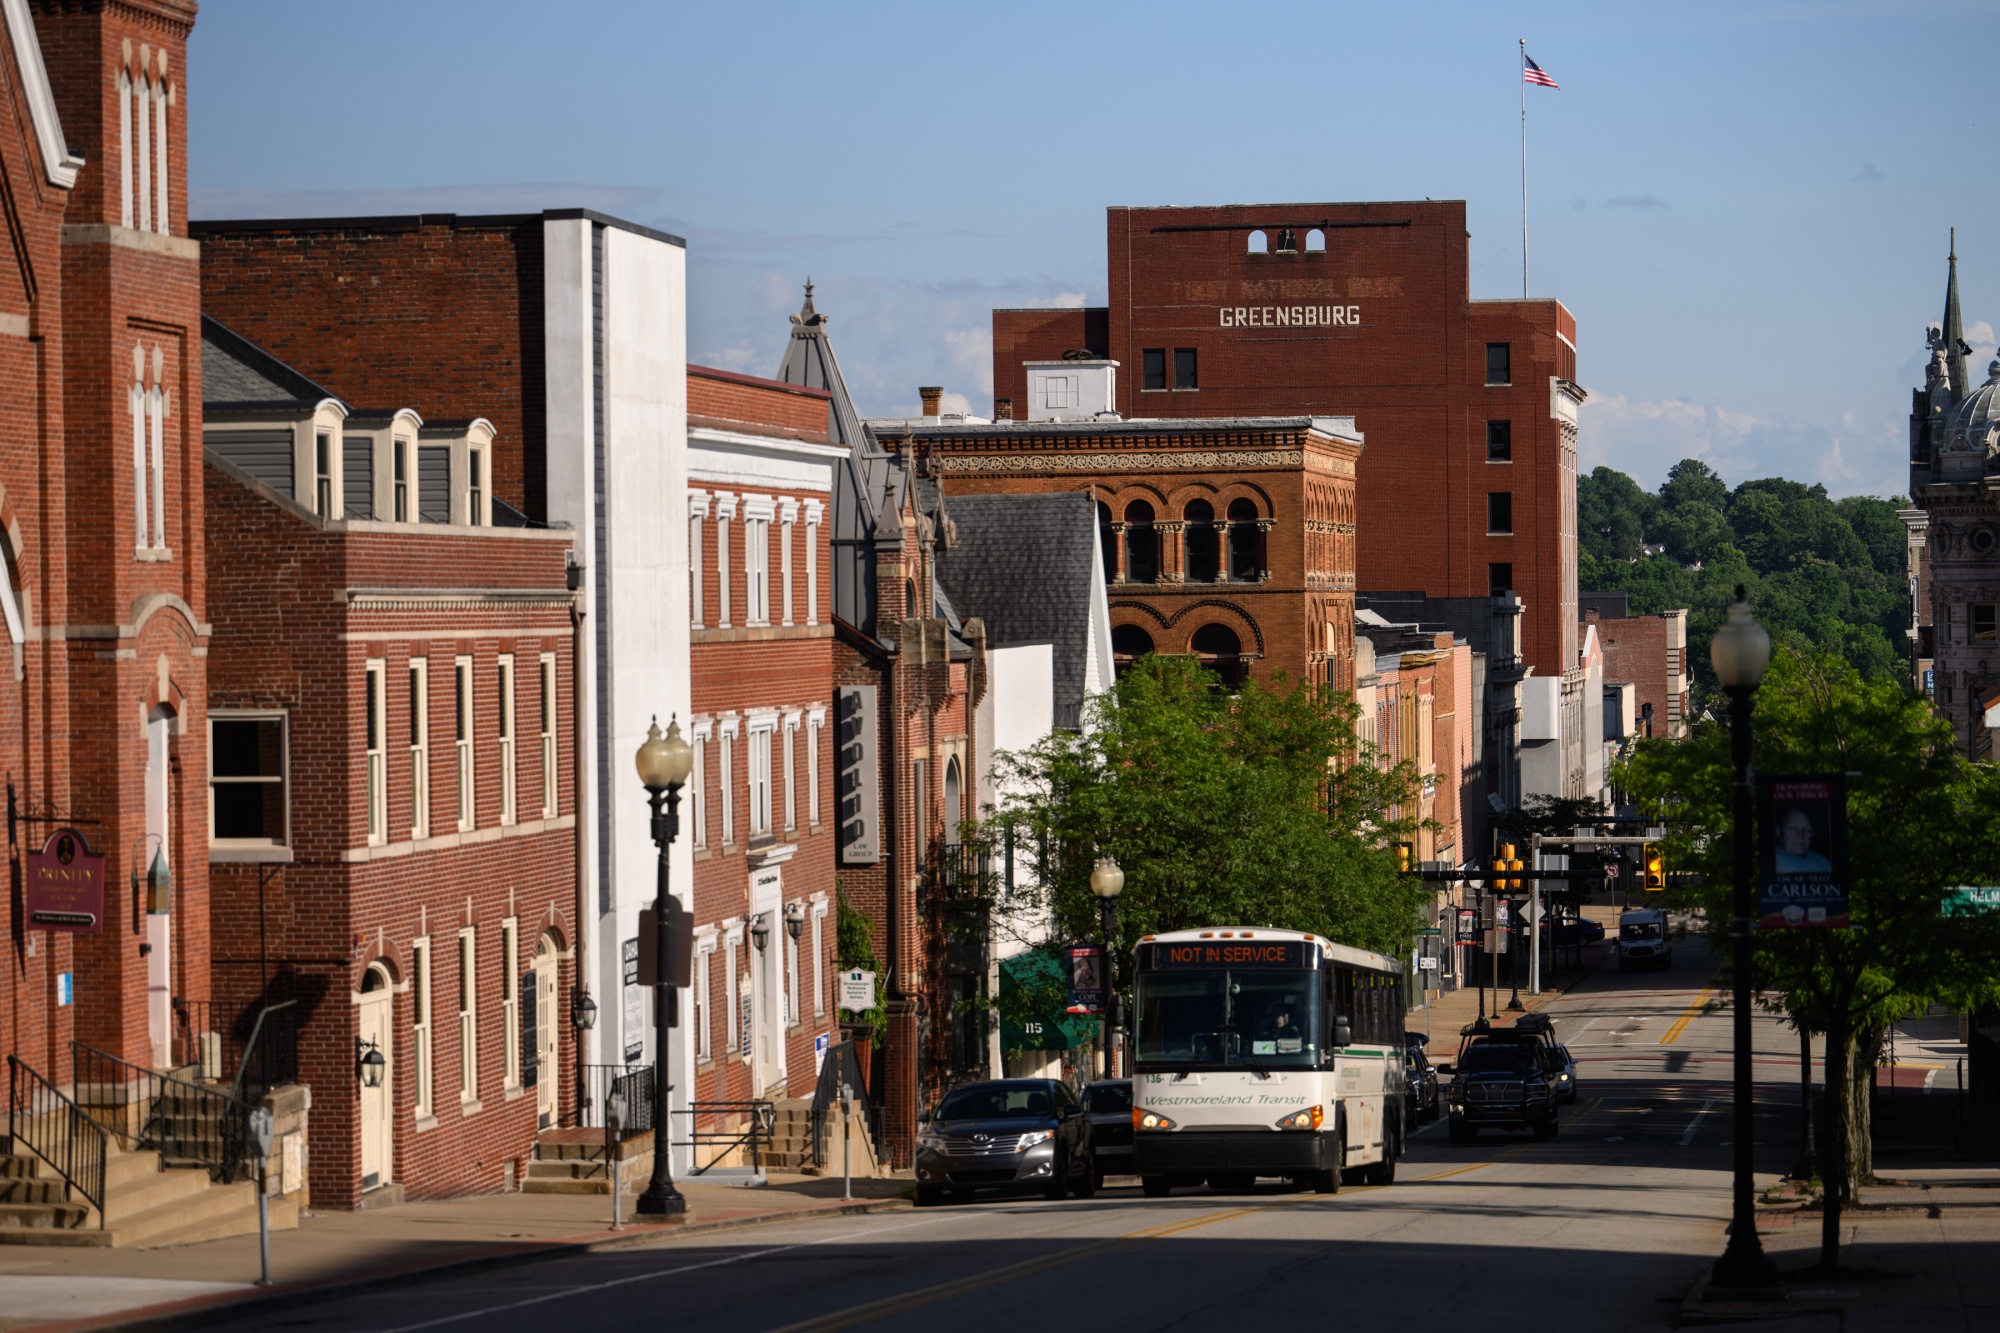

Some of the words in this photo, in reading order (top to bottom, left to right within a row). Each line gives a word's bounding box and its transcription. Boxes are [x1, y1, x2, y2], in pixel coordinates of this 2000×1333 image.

[1219, 305, 1360, 327] GREENSBURG
[1775, 783, 1826, 791] HONORING
[1773, 791, 1793, 800] OUR
[1796, 791, 1829, 799] HEROES
[37, 867, 95, 880] TRINITY
[1768, 883, 1841, 897] CARLSON
[1170, 947, 1202, 962] NOT
[1206, 947, 1220, 962] IN
[1223, 946, 1286, 962] SERVICE
[1025, 1022, 1043, 1034] 115
[1145, 1074, 1162, 1083] 136
[1145, 1094, 1253, 1106] Westmoreland
[1258, 1094, 1307, 1105] Transit
